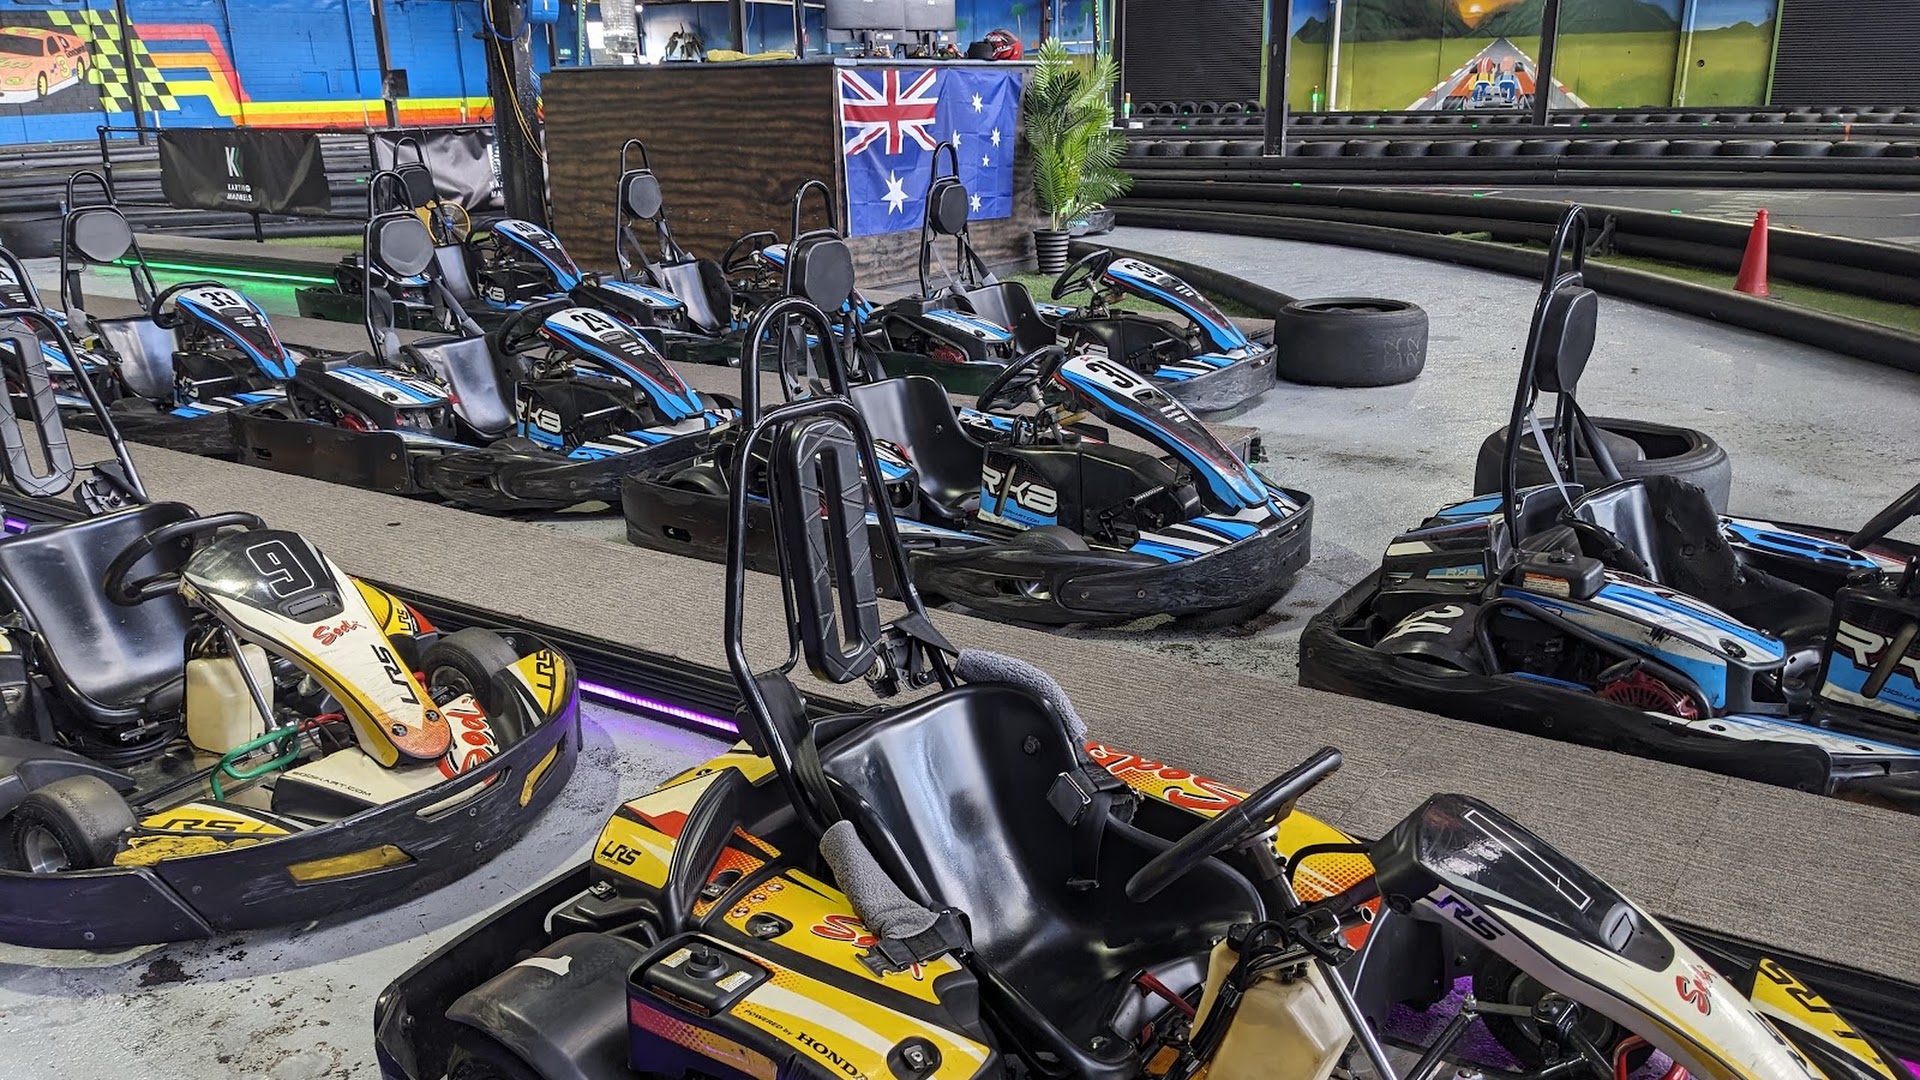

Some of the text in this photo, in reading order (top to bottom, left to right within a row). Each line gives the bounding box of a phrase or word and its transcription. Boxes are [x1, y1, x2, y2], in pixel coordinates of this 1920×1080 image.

[200, 291, 241, 308] 33
[570, 312, 615, 333] 29
[981, 463, 1058, 515] RX8
[245, 540, 316, 598] 9
[371, 644, 420, 705] LRS
[535, 648, 554, 691] LRS
[161, 817, 245, 832] RS
[601, 840, 642, 866] LRS
[744, 1009, 783, 1032] POWERED
[783, 1027, 793, 1036] by
